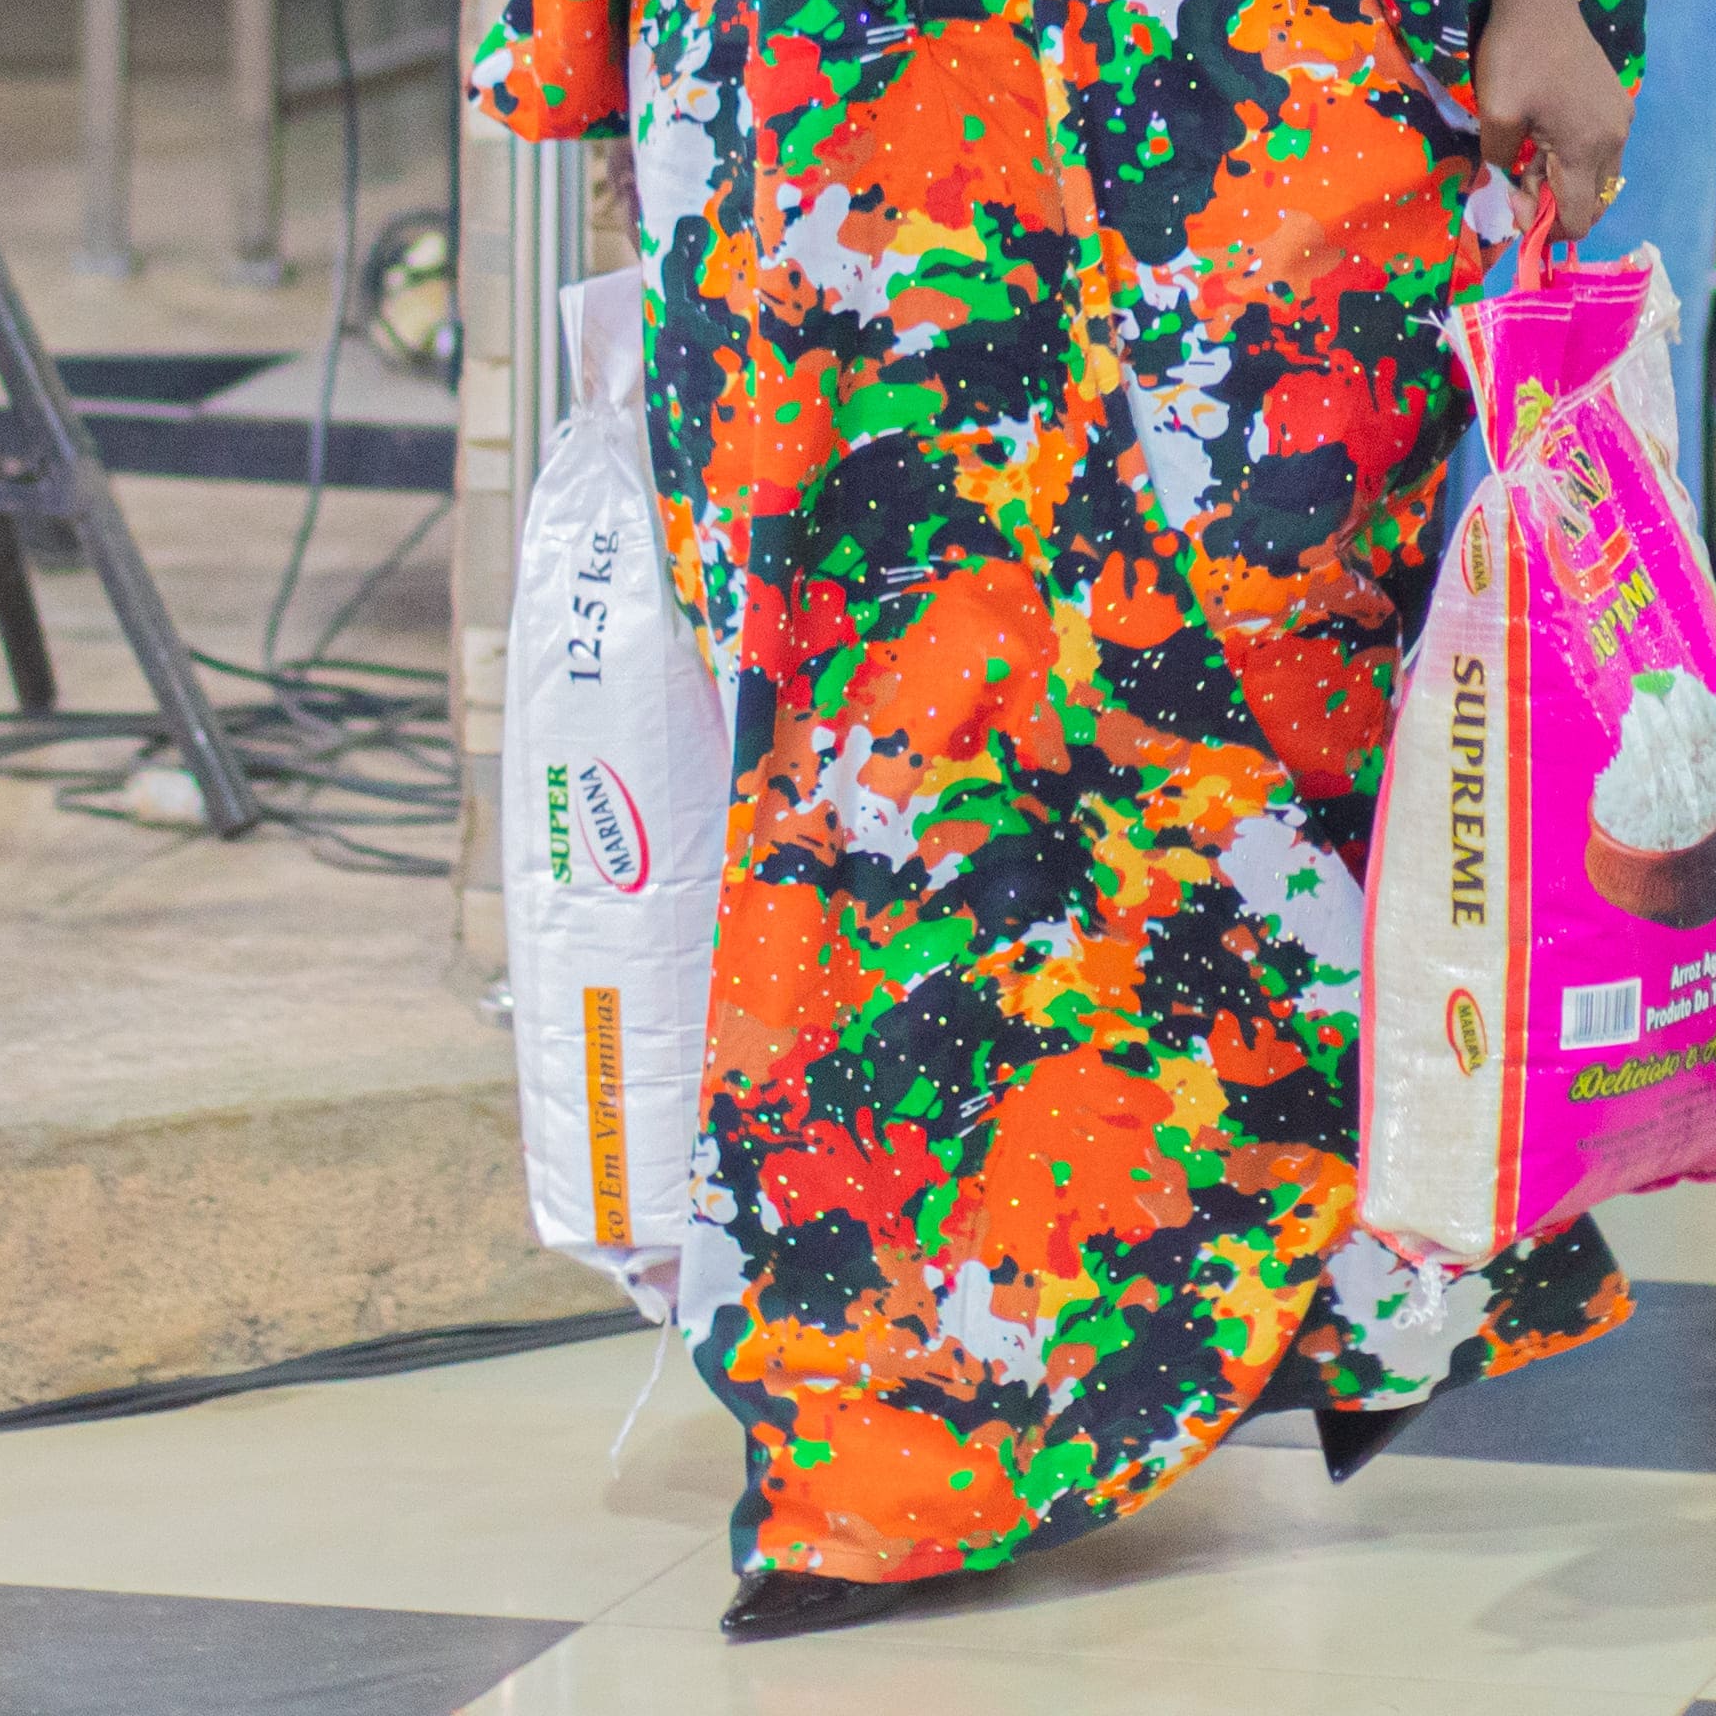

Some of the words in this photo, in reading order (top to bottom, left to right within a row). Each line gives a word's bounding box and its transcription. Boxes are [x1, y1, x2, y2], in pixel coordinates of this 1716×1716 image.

[578, 529, 619, 585] kg
[568, 594, 608, 685] 12.5
[547, 763, 572, 884] SUPER
[579, 765, 636, 877] MARIANA
[1452, 654, 1487, 927] SUPREME
[1645, 996, 1693, 1032] Produto
[1694, 988, 1710, 1014] Da
[1670, 959, 1701, 990] Arroz
[591, 989, 619, 1141] Vitaminas
[1457, 1004, 1483, 1072] MARIANA
[598, 1152, 623, 1200] Em
